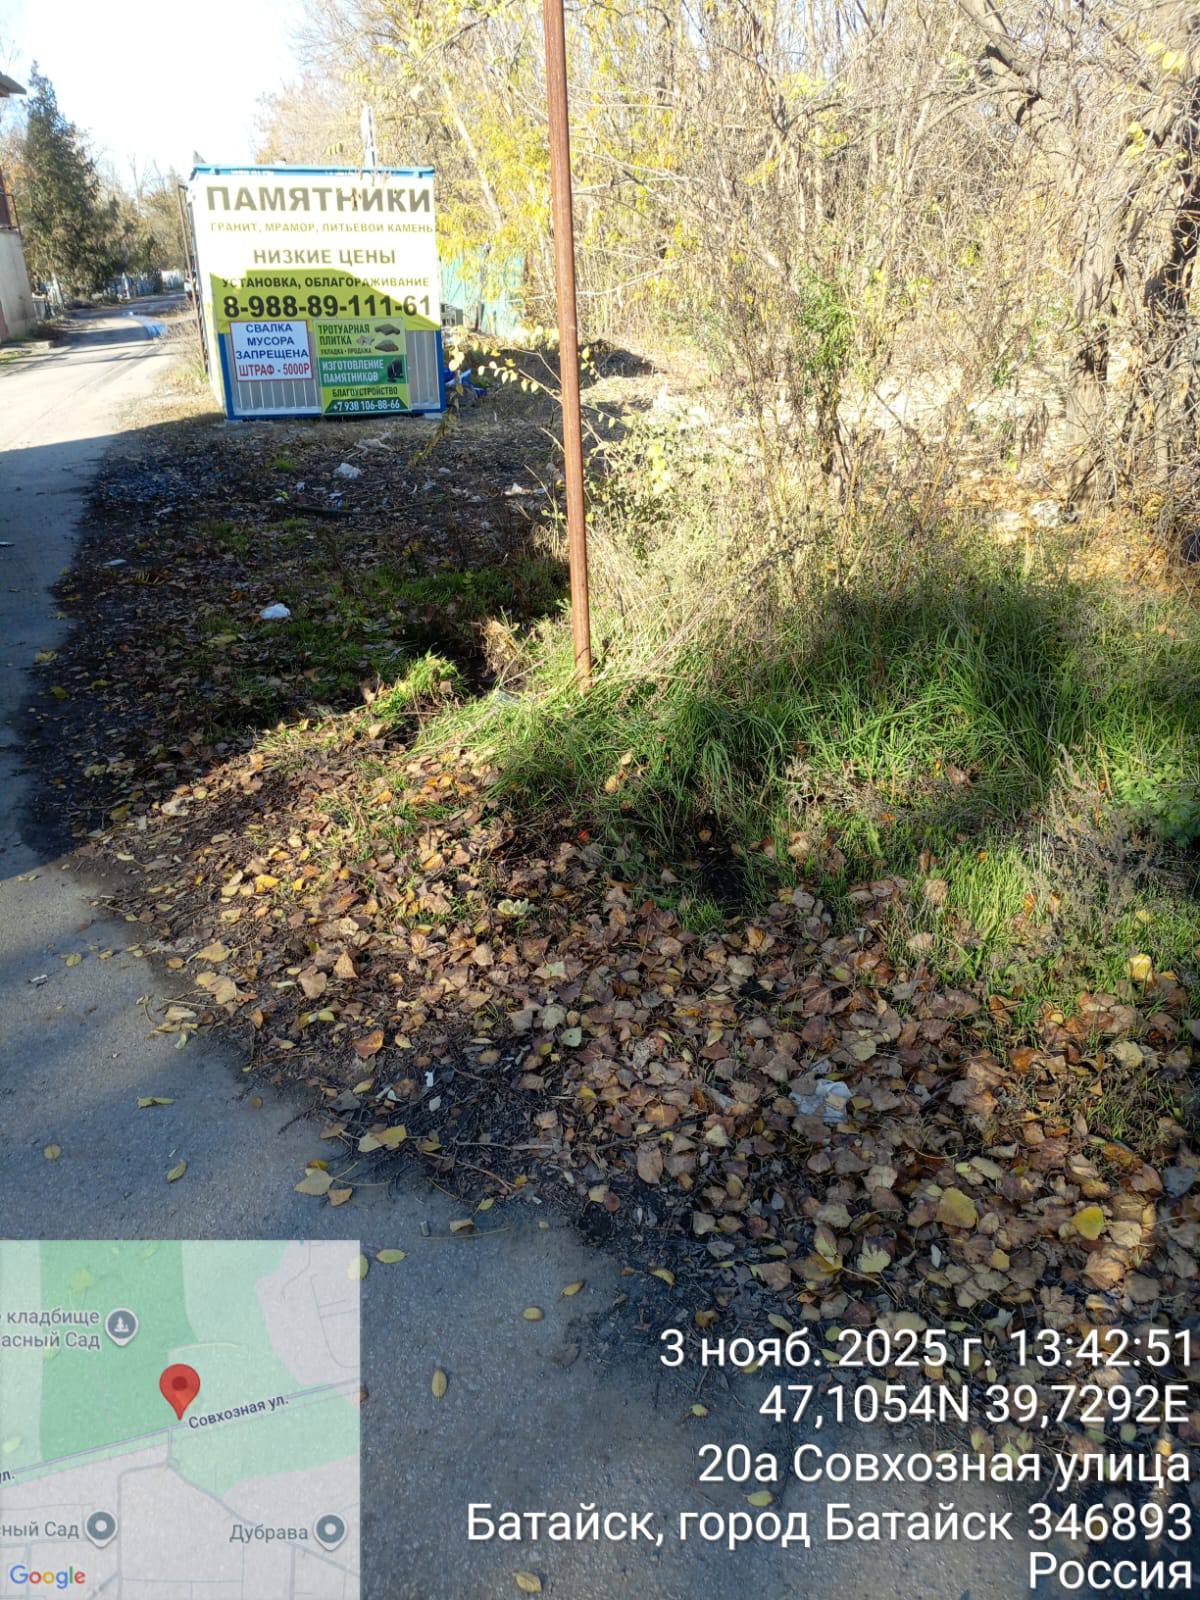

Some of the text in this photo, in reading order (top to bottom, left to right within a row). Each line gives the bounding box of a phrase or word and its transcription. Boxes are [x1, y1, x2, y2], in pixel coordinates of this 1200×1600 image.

[206, 186, 431, 213] ПАМЯТНИКИ
[387, 223, 433, 233] КАМЕНЬ
[253, 249, 396, 267] НИЗКИЕ ЦЕНЫ
[222, 277, 429, 290] УСТАНОВКА, ОБЛАГОРАЖИВАНИЕ
[223, 294, 431, 318] 8-988-89-111-61
[245, 323, 293, 333] СВАЛКА
[318, 324, 370, 334] ТРОТУАРНАЯ
[247, 336, 294, 346] МУСОРА
[320, 335, 352, 345] ПЛИТКА
[236, 349, 309, 360] ЗАПРЕЩЕНА
[239, 364, 275, 377] ШТРАФ
[283, 362, 310, 375] 5000Р
[322, 359, 384, 371] ИЗГОТОВЛЕНИЕ
[323, 372, 379, 384] ПАМЯТНИКОВ
[332, 386, 398, 397] БЛАГОУСТРОЙСТВО
[333, 402, 343, 411] +7
[344, 401, 359, 410] 938
